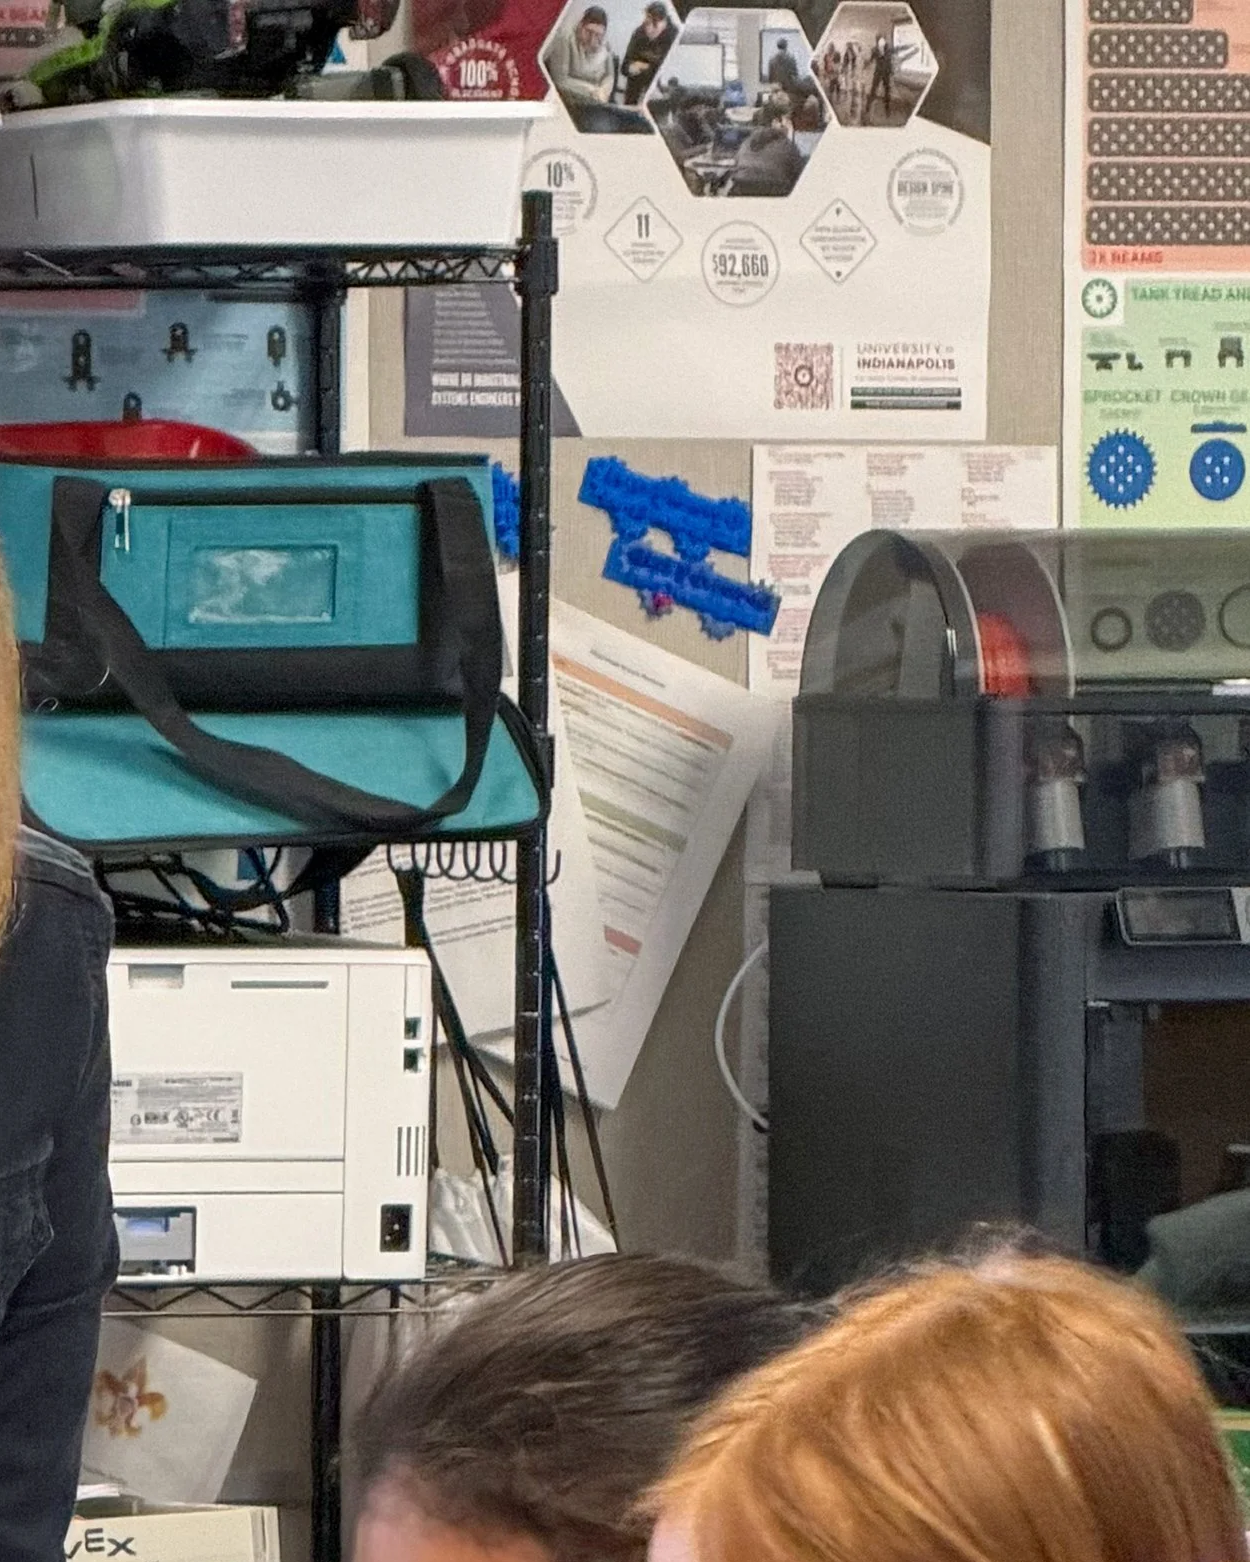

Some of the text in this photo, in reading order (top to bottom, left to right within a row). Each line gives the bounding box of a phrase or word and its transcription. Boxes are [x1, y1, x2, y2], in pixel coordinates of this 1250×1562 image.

[460, 59, 498, 88] 100%
[547, 161, 575, 187] 10%
[712, 253, 770, 278] $92,660
[856, 343, 941, 355] UNIVERSITY
[856, 357, 956, 370] INDIANAPOLIS
